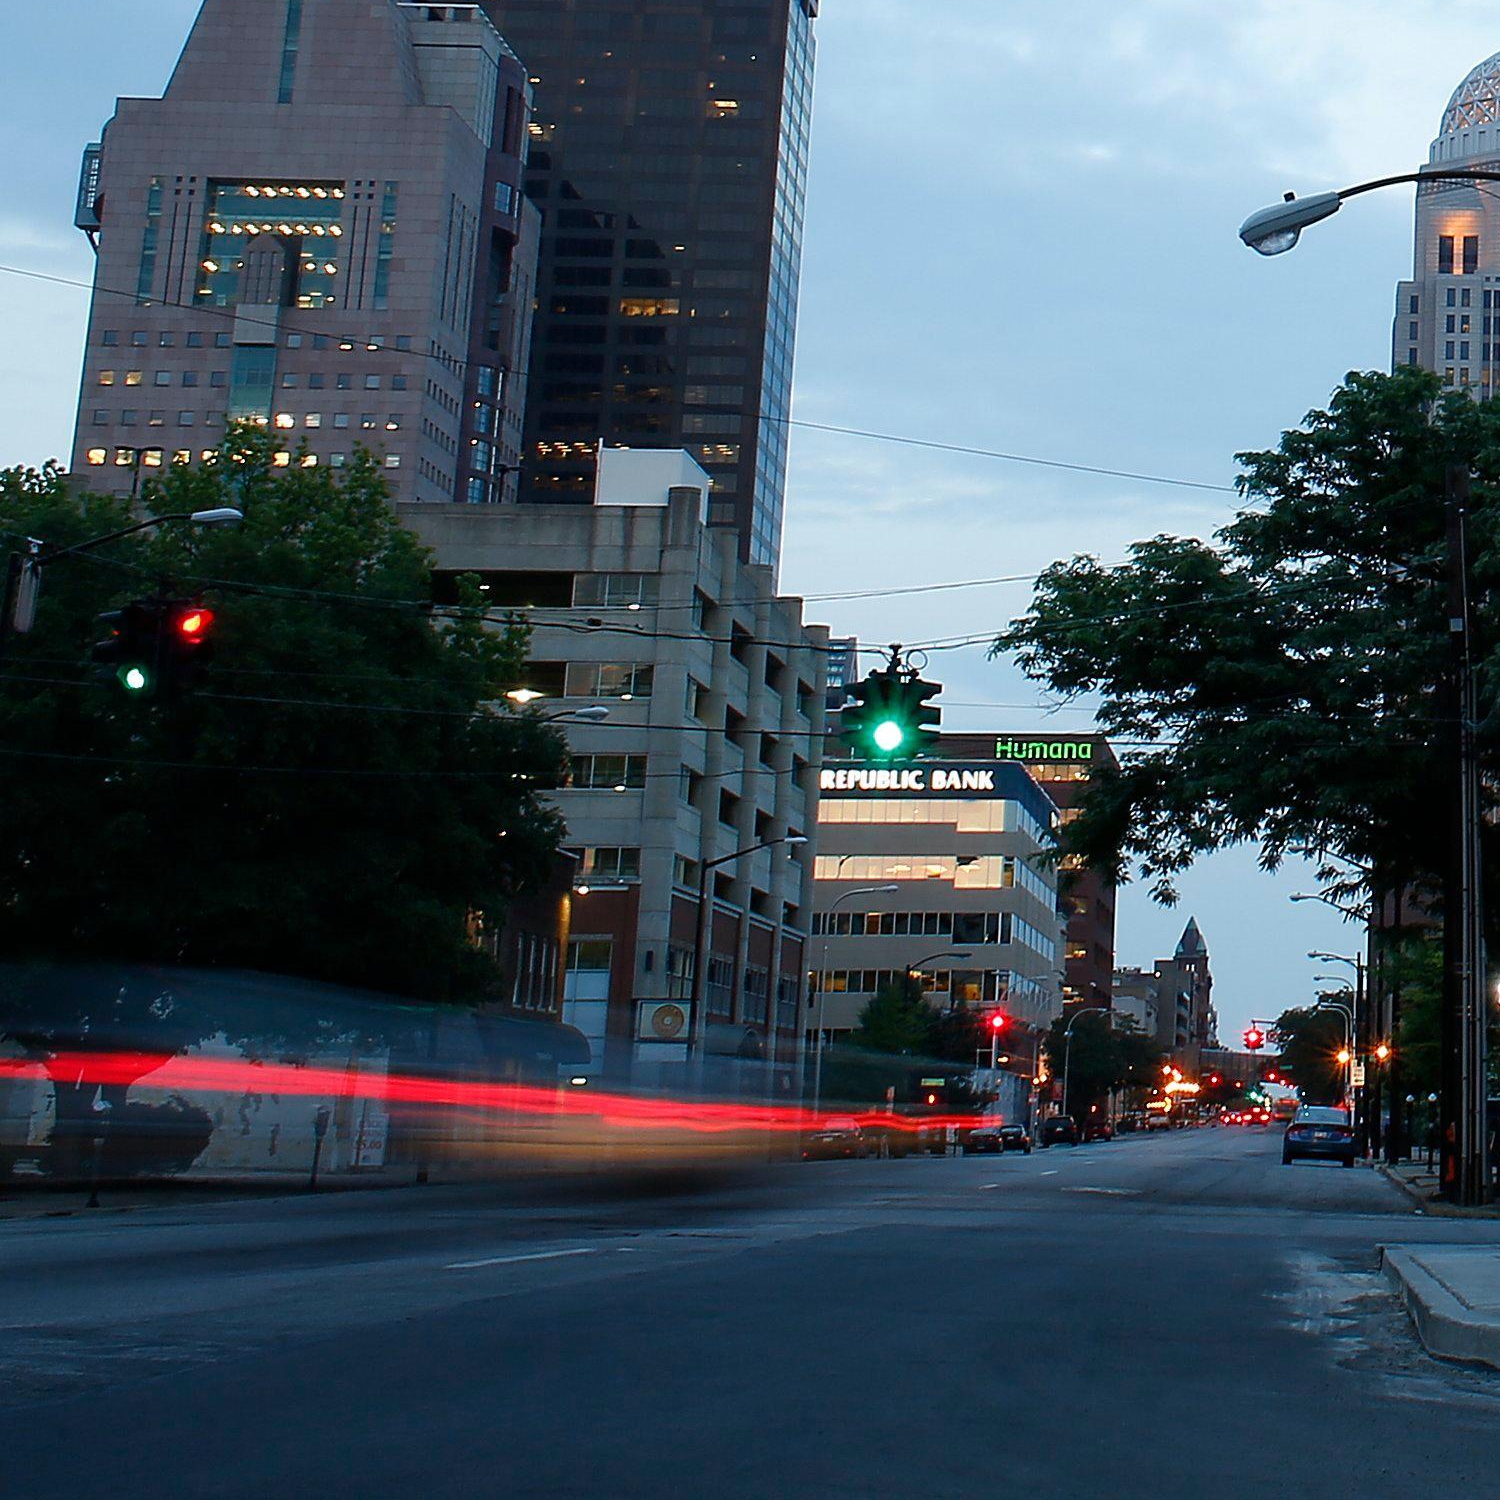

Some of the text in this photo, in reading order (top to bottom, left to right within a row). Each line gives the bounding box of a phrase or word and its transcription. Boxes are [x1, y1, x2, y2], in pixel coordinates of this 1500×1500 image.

[994, 737, 1093, 760] Humana
[819, 768, 995, 792] REPUBLIC BANK
